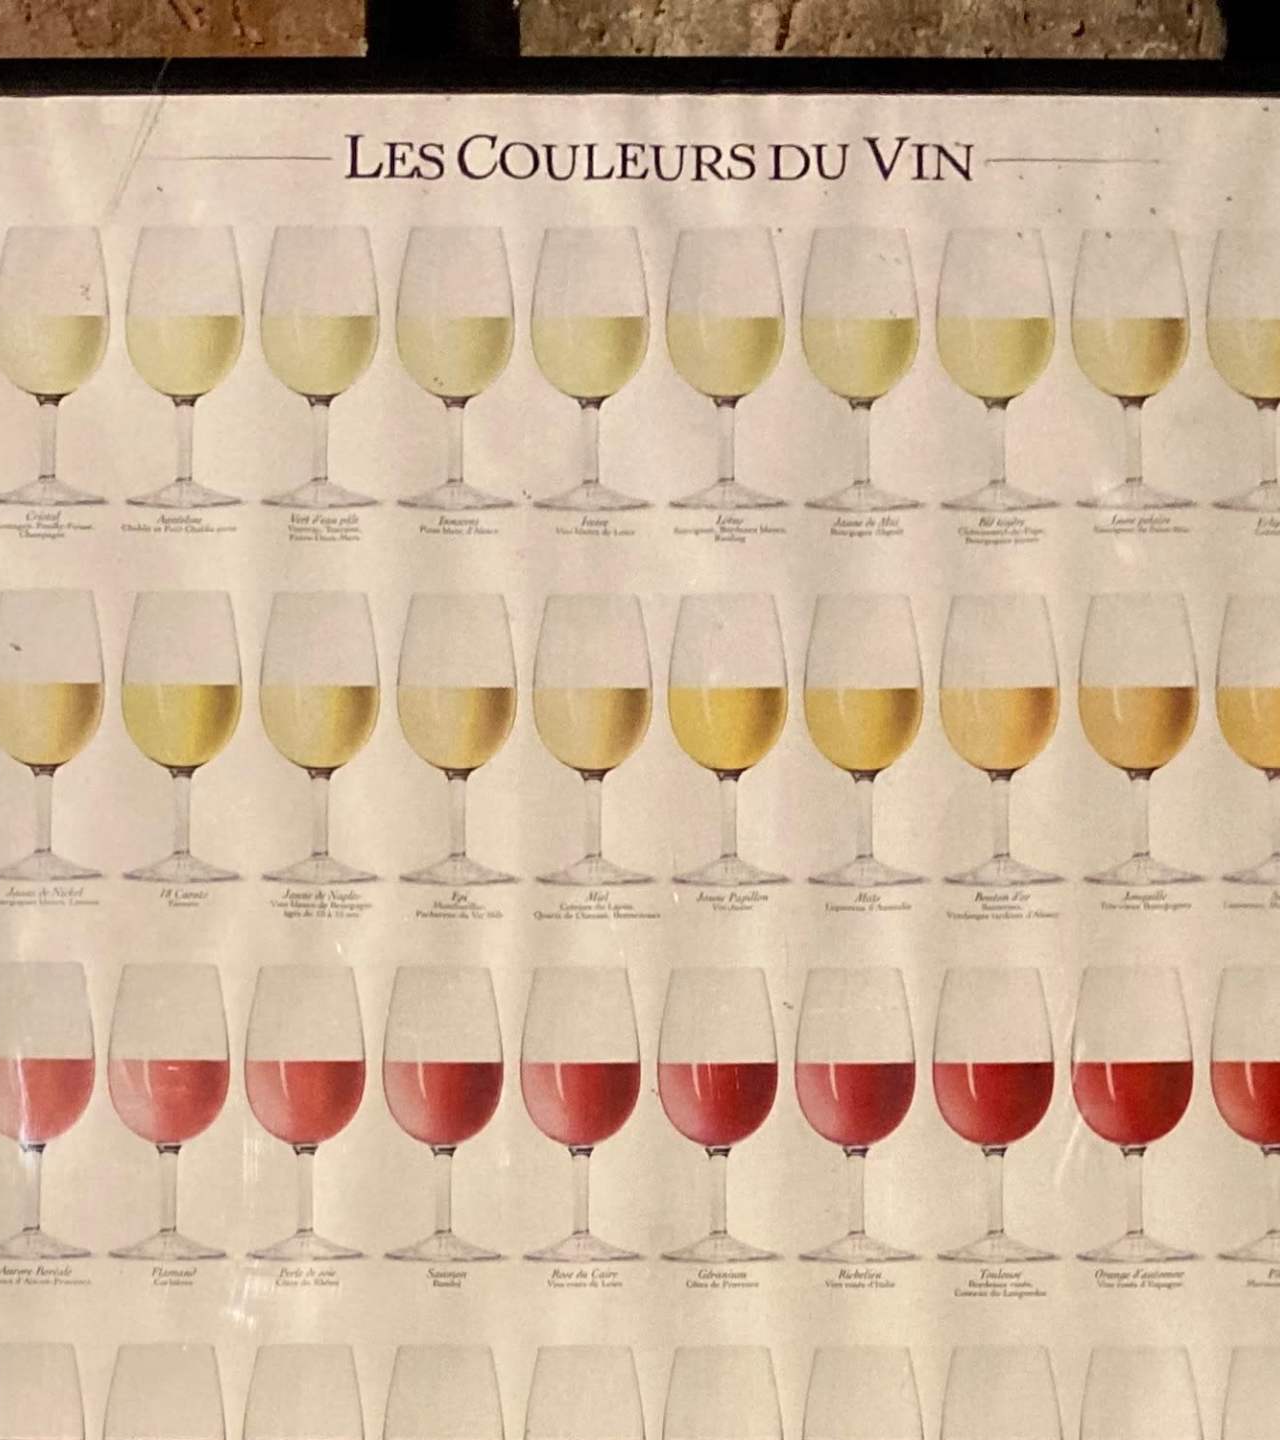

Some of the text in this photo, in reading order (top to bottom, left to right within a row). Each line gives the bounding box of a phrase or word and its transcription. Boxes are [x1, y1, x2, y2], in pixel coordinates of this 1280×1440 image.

[345, 133, 974, 181] LES COULEURS DU VIN
